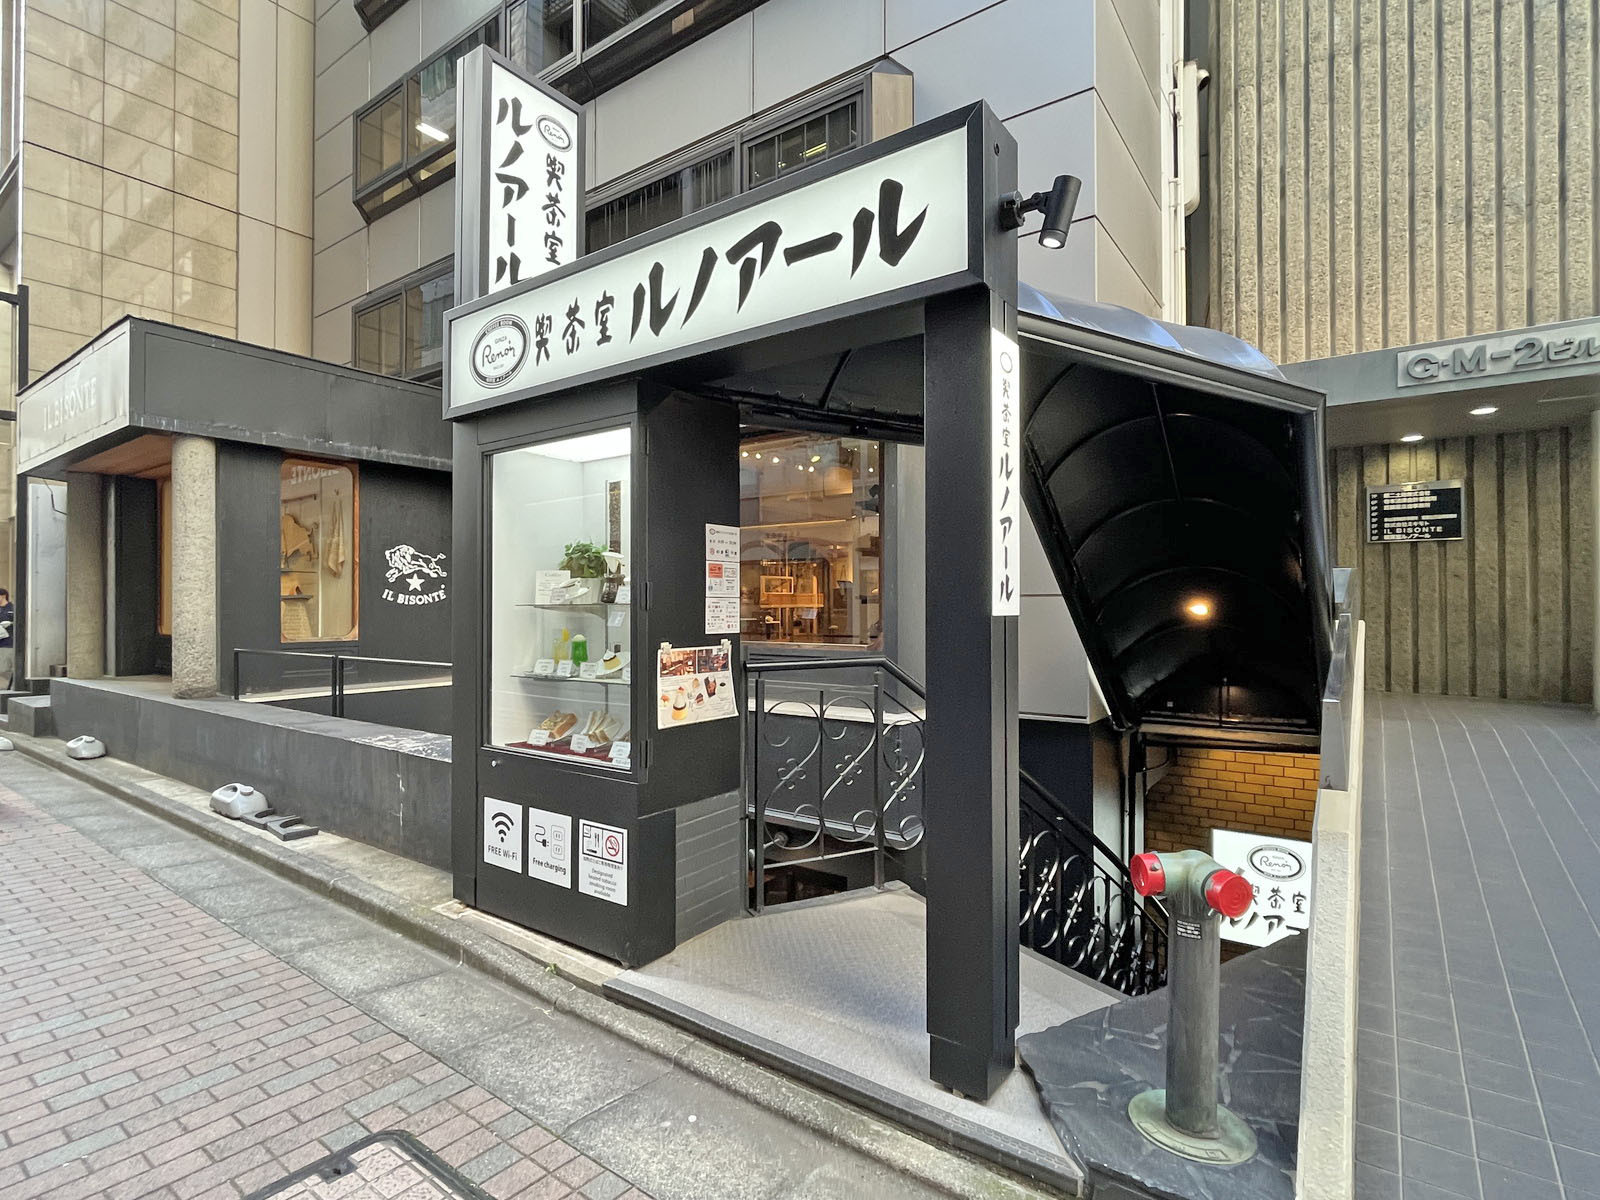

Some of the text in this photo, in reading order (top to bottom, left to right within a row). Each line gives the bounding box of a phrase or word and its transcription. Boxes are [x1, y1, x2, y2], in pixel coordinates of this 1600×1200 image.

[495, 97, 533, 285] ルノアール
[541, 153, 566, 265] 喫茶室
[1396, 526, 1443, 534] BISONTE
[382, 589, 446, 605] IL BISONTE
[487, 845, 518, 861] FREE Wi-Fi
[533, 857, 567, 875] Free charging
